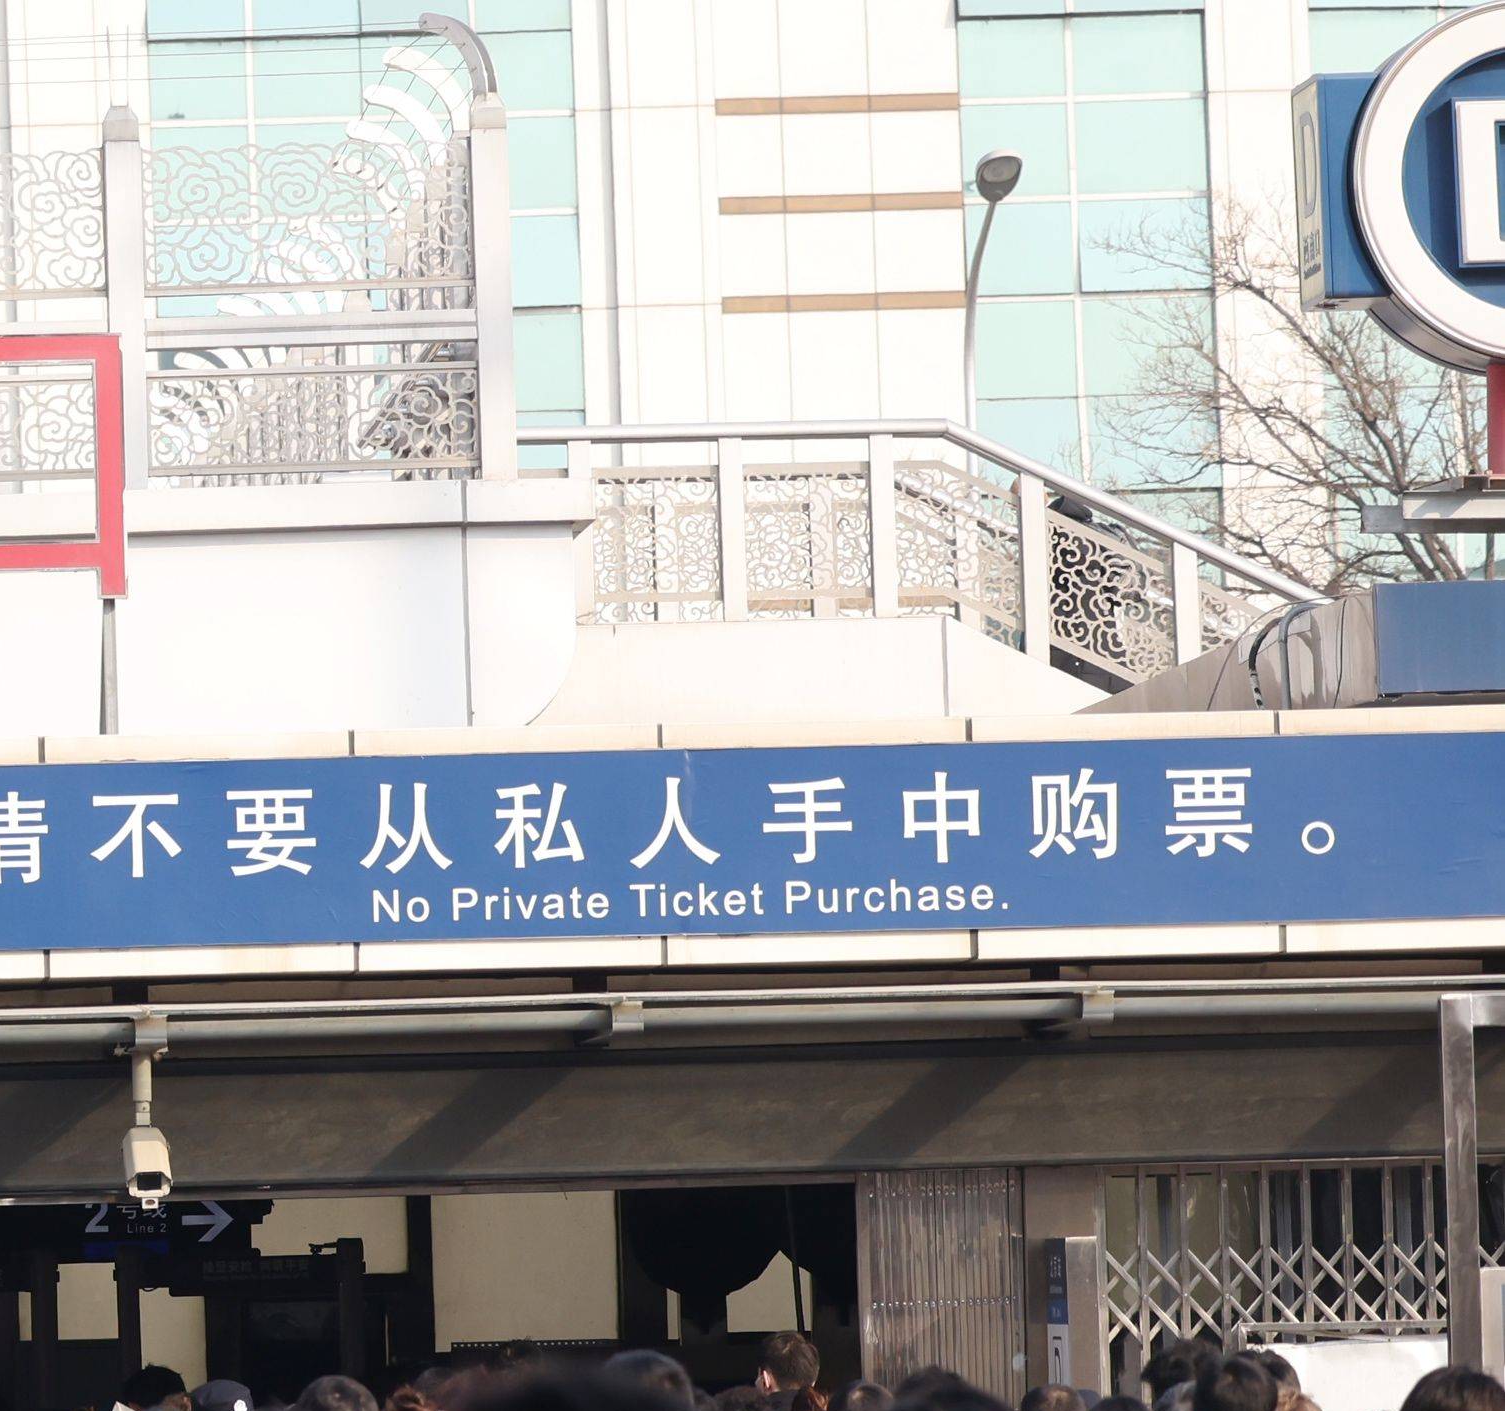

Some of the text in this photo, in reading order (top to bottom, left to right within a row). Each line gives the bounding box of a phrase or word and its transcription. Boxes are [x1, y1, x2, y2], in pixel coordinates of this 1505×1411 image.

[373, 879, 1008, 922] No Private Ticket Purchase.
[85, 1203, 109, 1233] 2
[127, 1223, 168, 1233] Line 2
